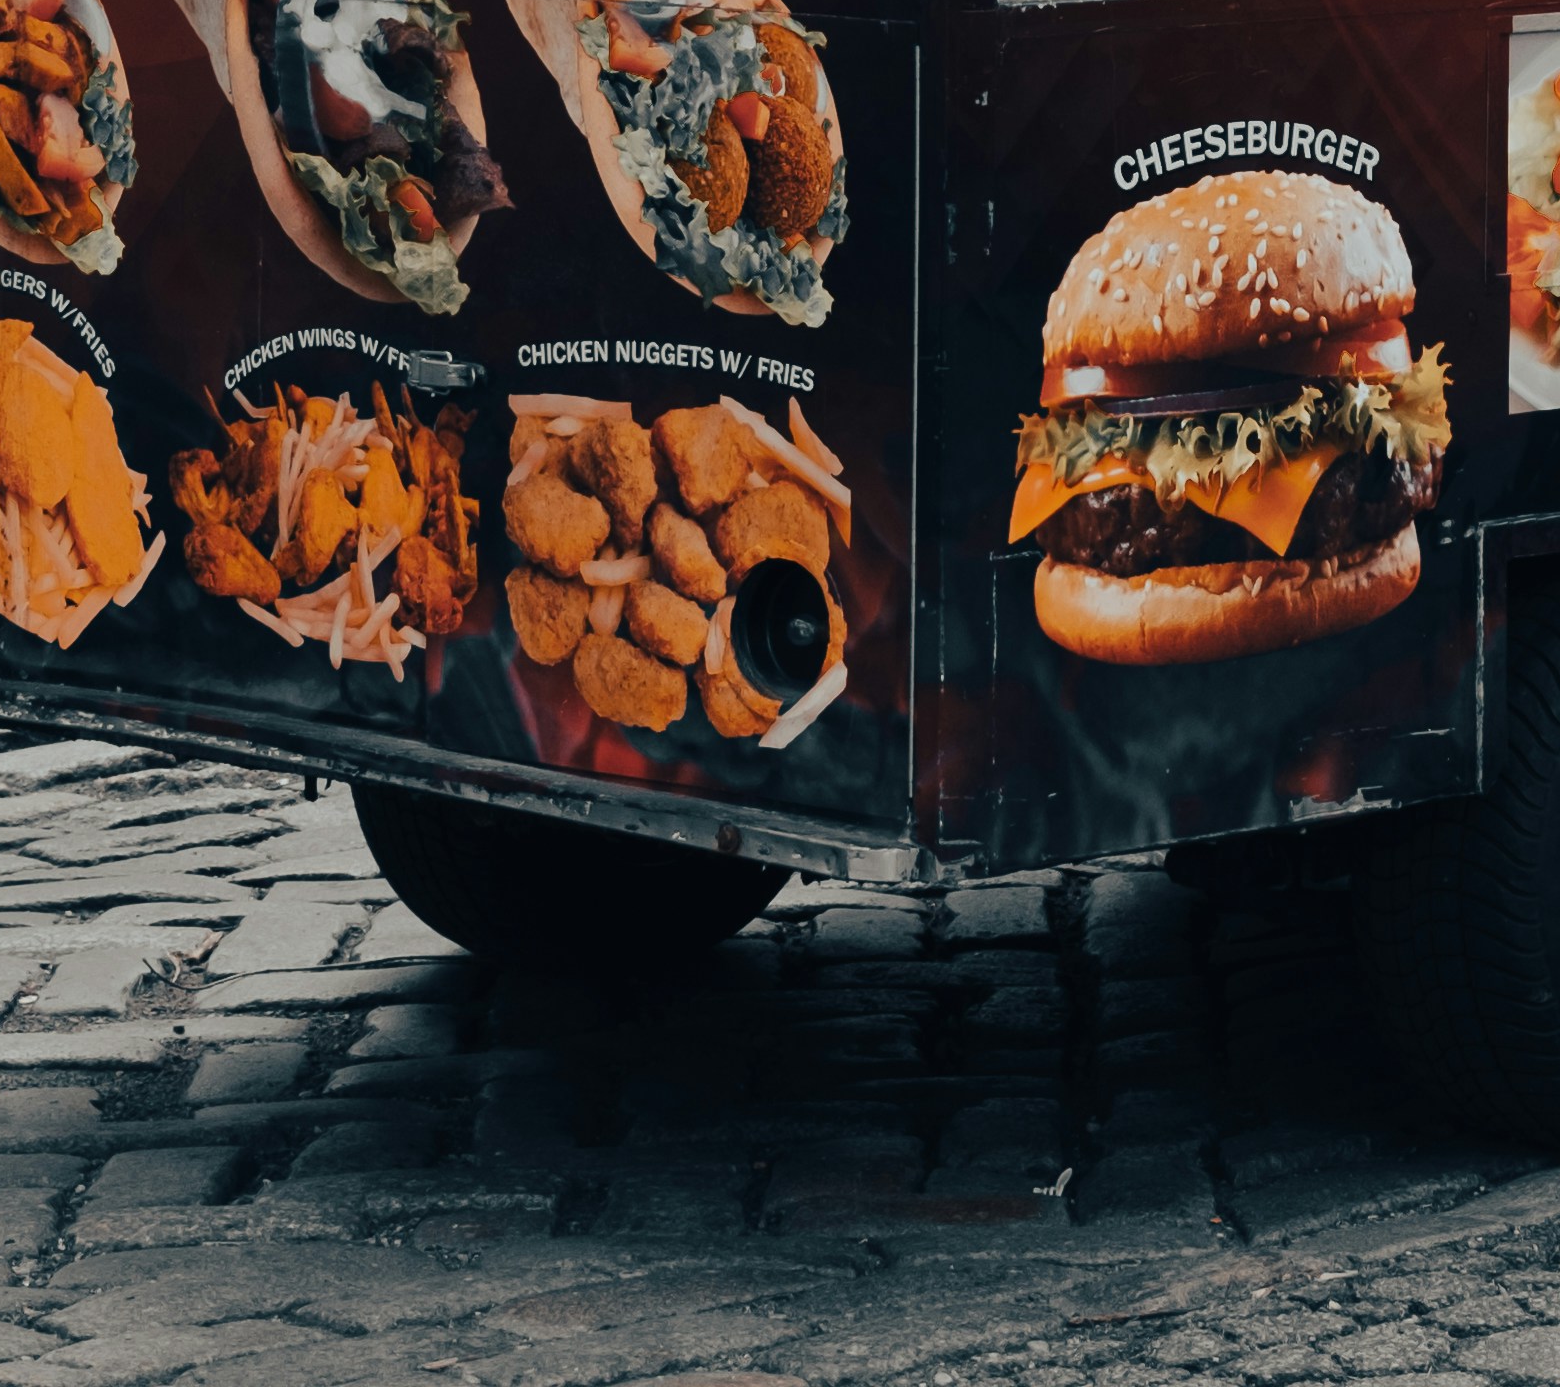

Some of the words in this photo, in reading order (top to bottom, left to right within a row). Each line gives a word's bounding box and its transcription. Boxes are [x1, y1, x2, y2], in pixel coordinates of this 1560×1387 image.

[1114, 120, 1380, 191] CHEESEBURGER
[224, 332, 294, 391] CHICKEN
[298, 328, 356, 351] WINGS
[361, 332, 409, 370] W/FR
